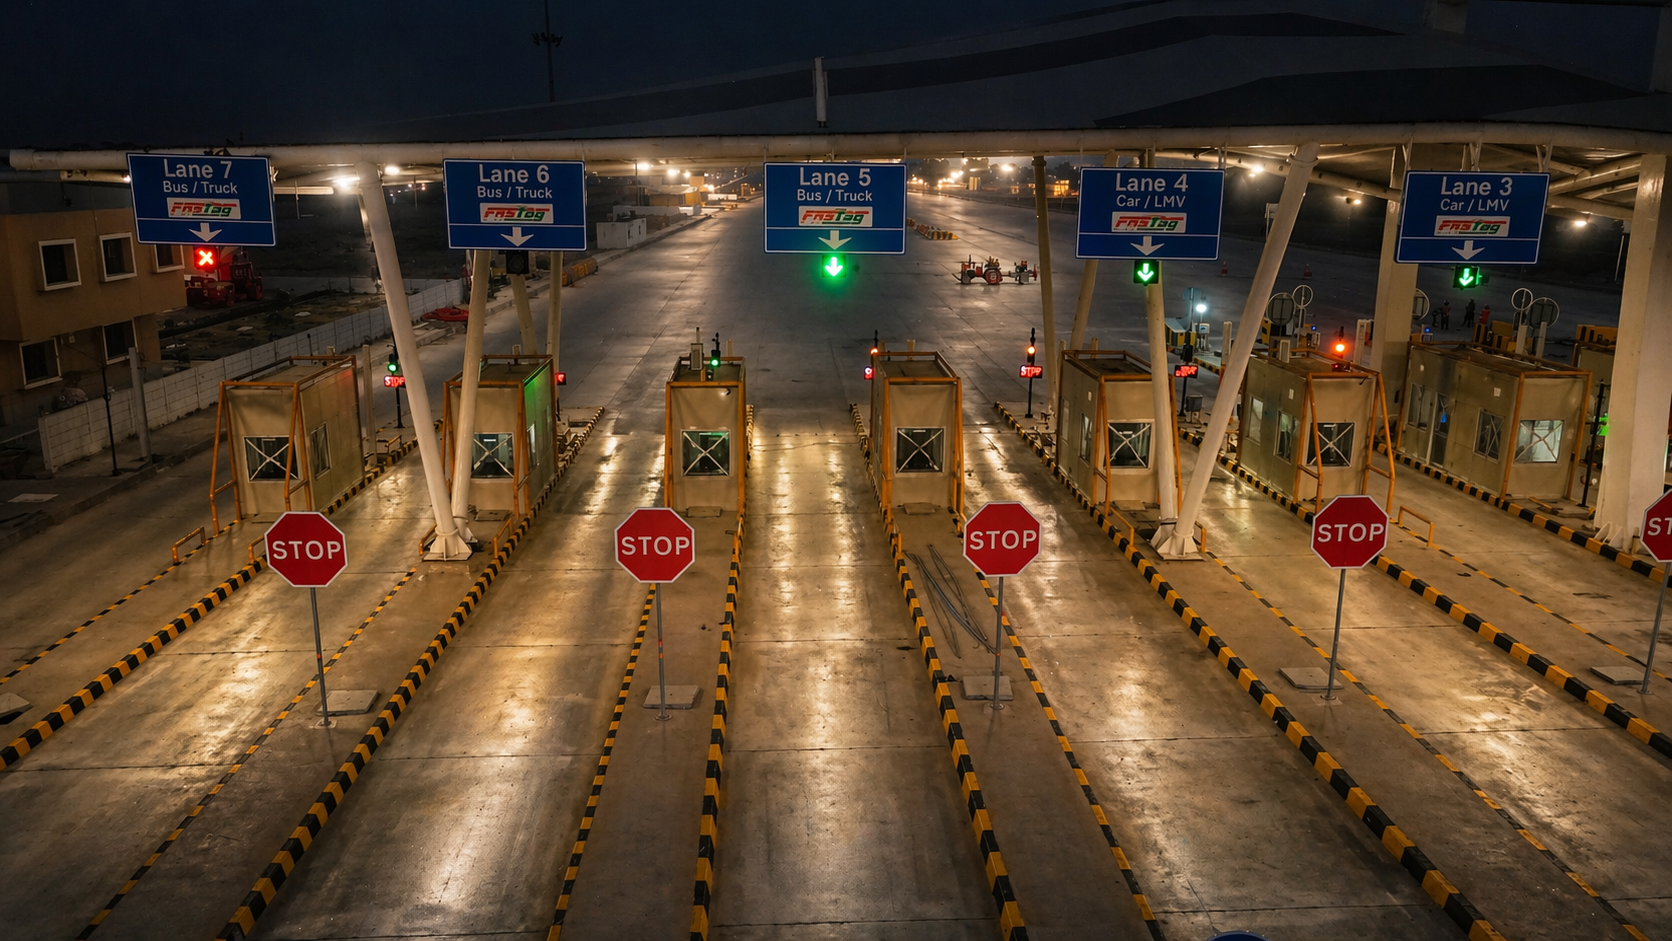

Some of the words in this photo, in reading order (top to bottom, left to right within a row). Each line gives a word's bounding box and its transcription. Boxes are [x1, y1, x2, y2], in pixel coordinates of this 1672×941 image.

[163, 159, 213, 178] Lane
[220, 161, 232, 179] 7
[479, 164, 529, 183] Lane
[536, 165, 550, 184] 6
[799, 167, 849, 186] Lane
[858, 168, 872, 187] 5
[163, 180, 188, 193] Bus
[192, 181, 198, 194] /
[201, 181, 238, 194] Truck
[477, 186, 502, 198] Bus
[506, 187, 512, 199] /
[515, 187, 553, 199] Truck
[1115, 173, 1166, 192] Lane
[1173, 173, 1188, 192] 4
[1440, 176, 1491, 196] Lane
[1499, 177, 1513, 196] 3
[797, 189, 821, 201] Bus
[825, 189, 832, 204] /
[835, 190, 873, 202] Truck
[1116, 194, 1141, 207] Car
[1144, 195, 1151, 209] /
[1154, 196, 1186, 208] LMV
[1440, 198, 1464, 211] Car
[1467, 199, 1475, 212] /
[1477, 199, 1510, 212] LMV
[969, 530, 1037, 550] STOP
[1317, 523, 1384, 543] STOP
[272, 540, 341, 560] STOP
[621, 536, 690, 556] STOP
